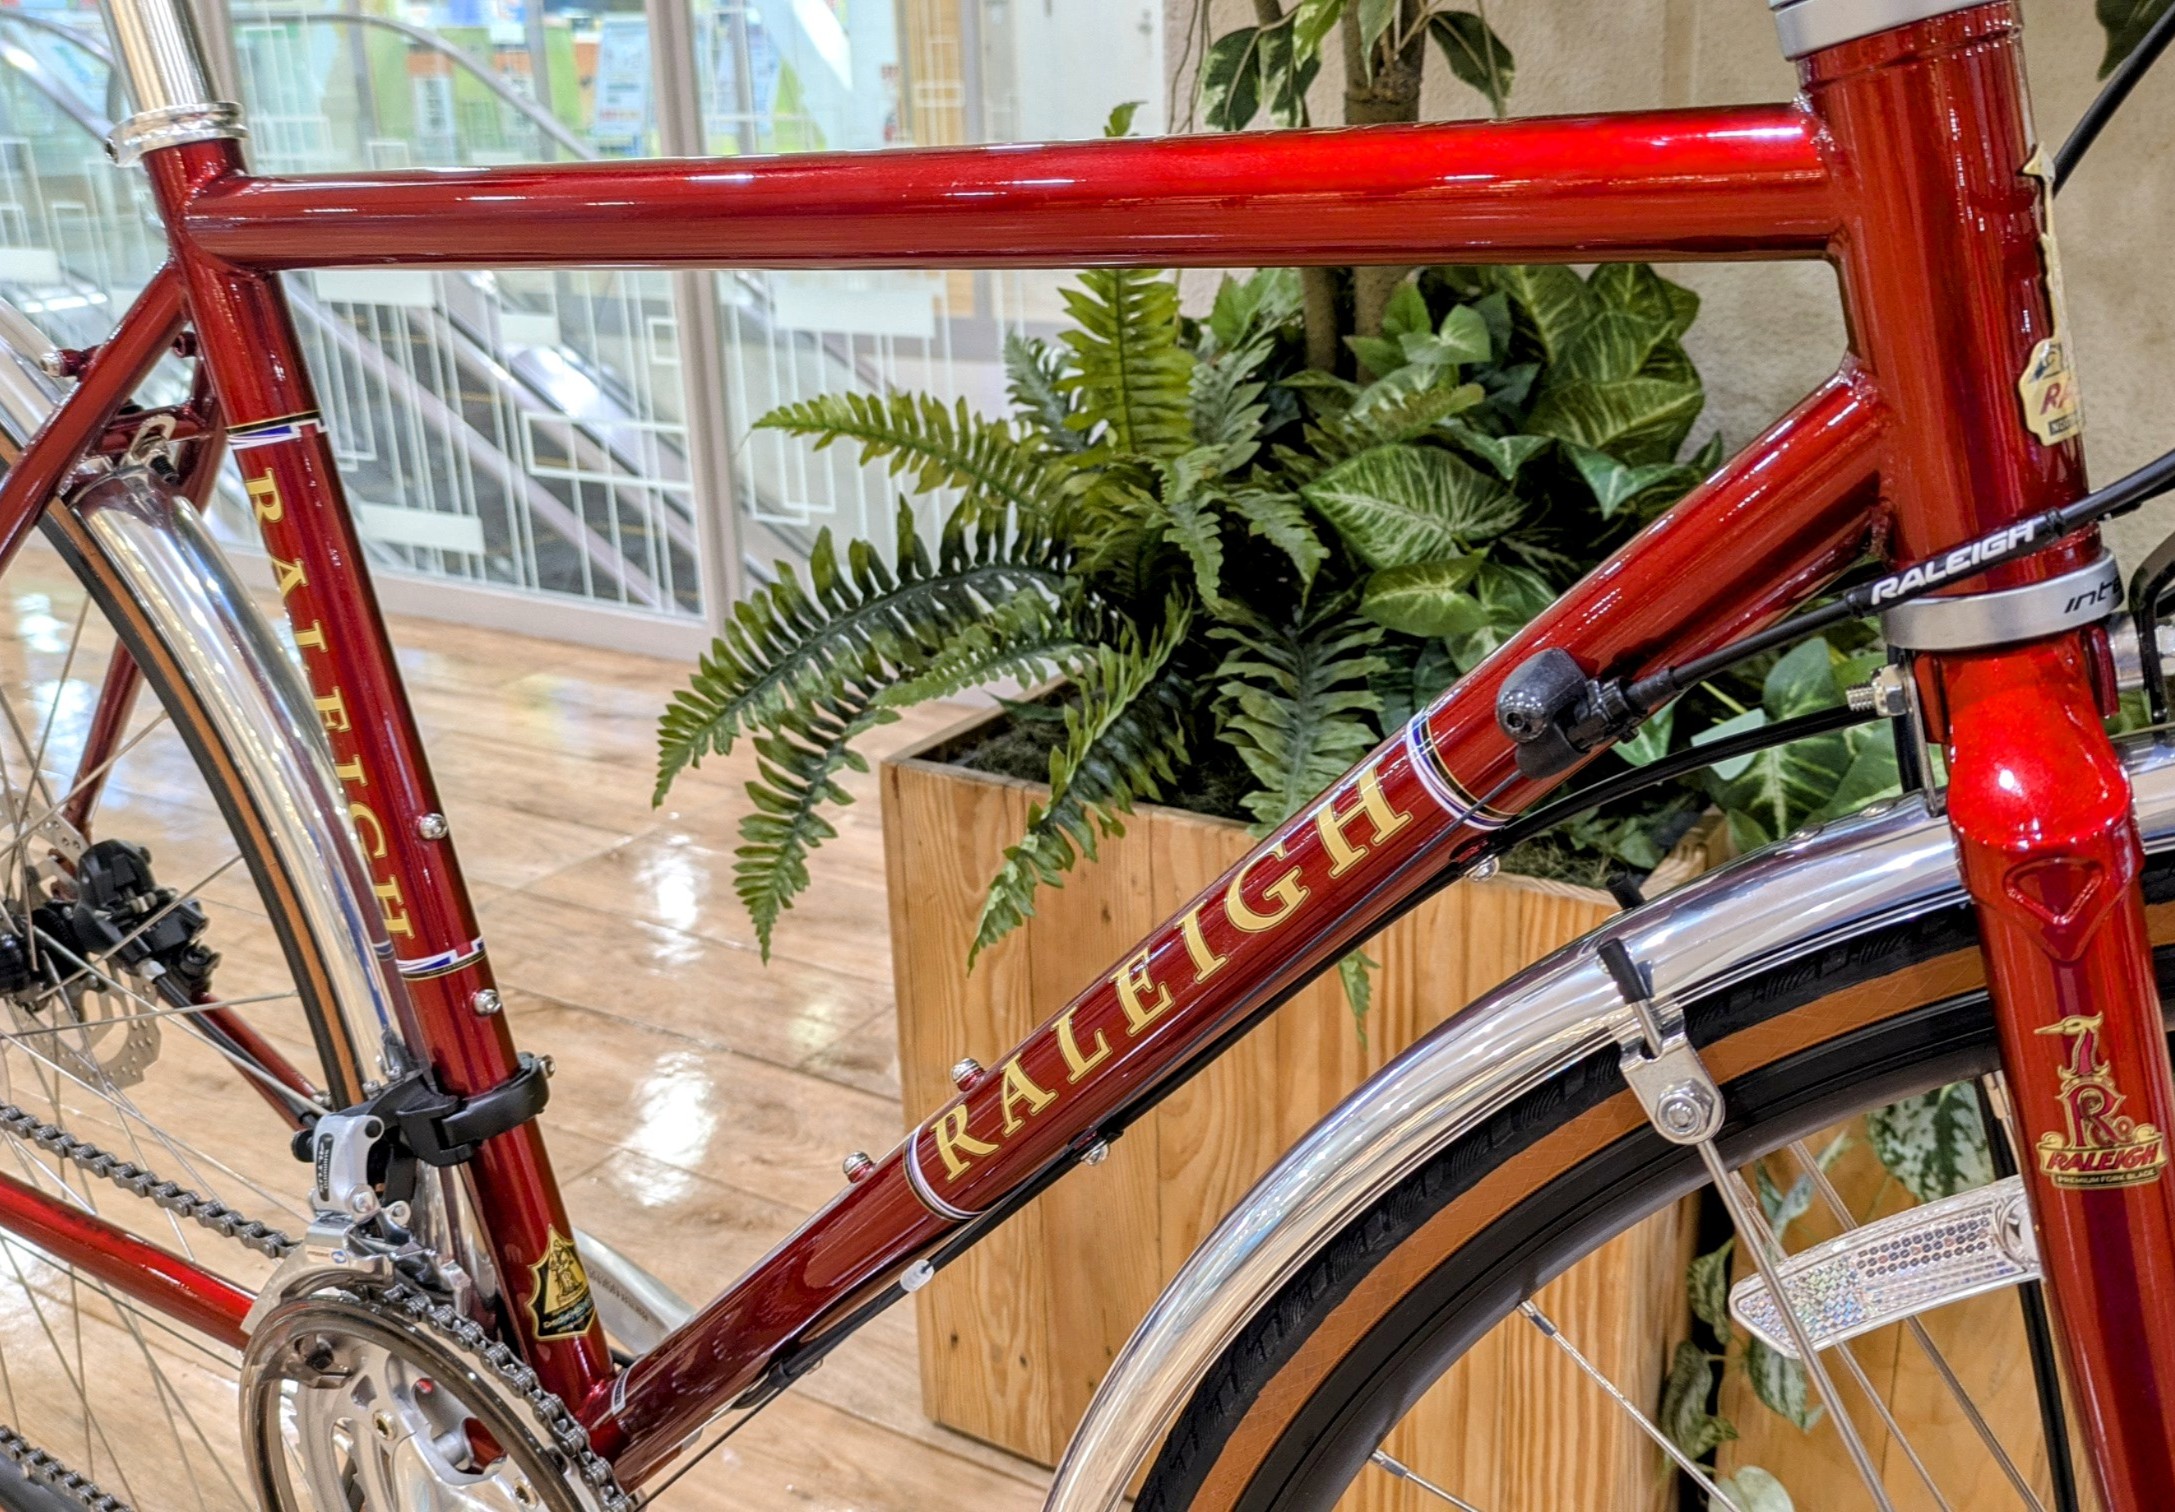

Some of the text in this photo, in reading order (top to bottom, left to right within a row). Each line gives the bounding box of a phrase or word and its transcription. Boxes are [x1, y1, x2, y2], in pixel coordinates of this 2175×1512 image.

[1870, 518, 2036, 605] RALEIGH
[930, 766, 1413, 1183] RALEIGH
[2046, 1142, 2159, 1171] RALEIGH
